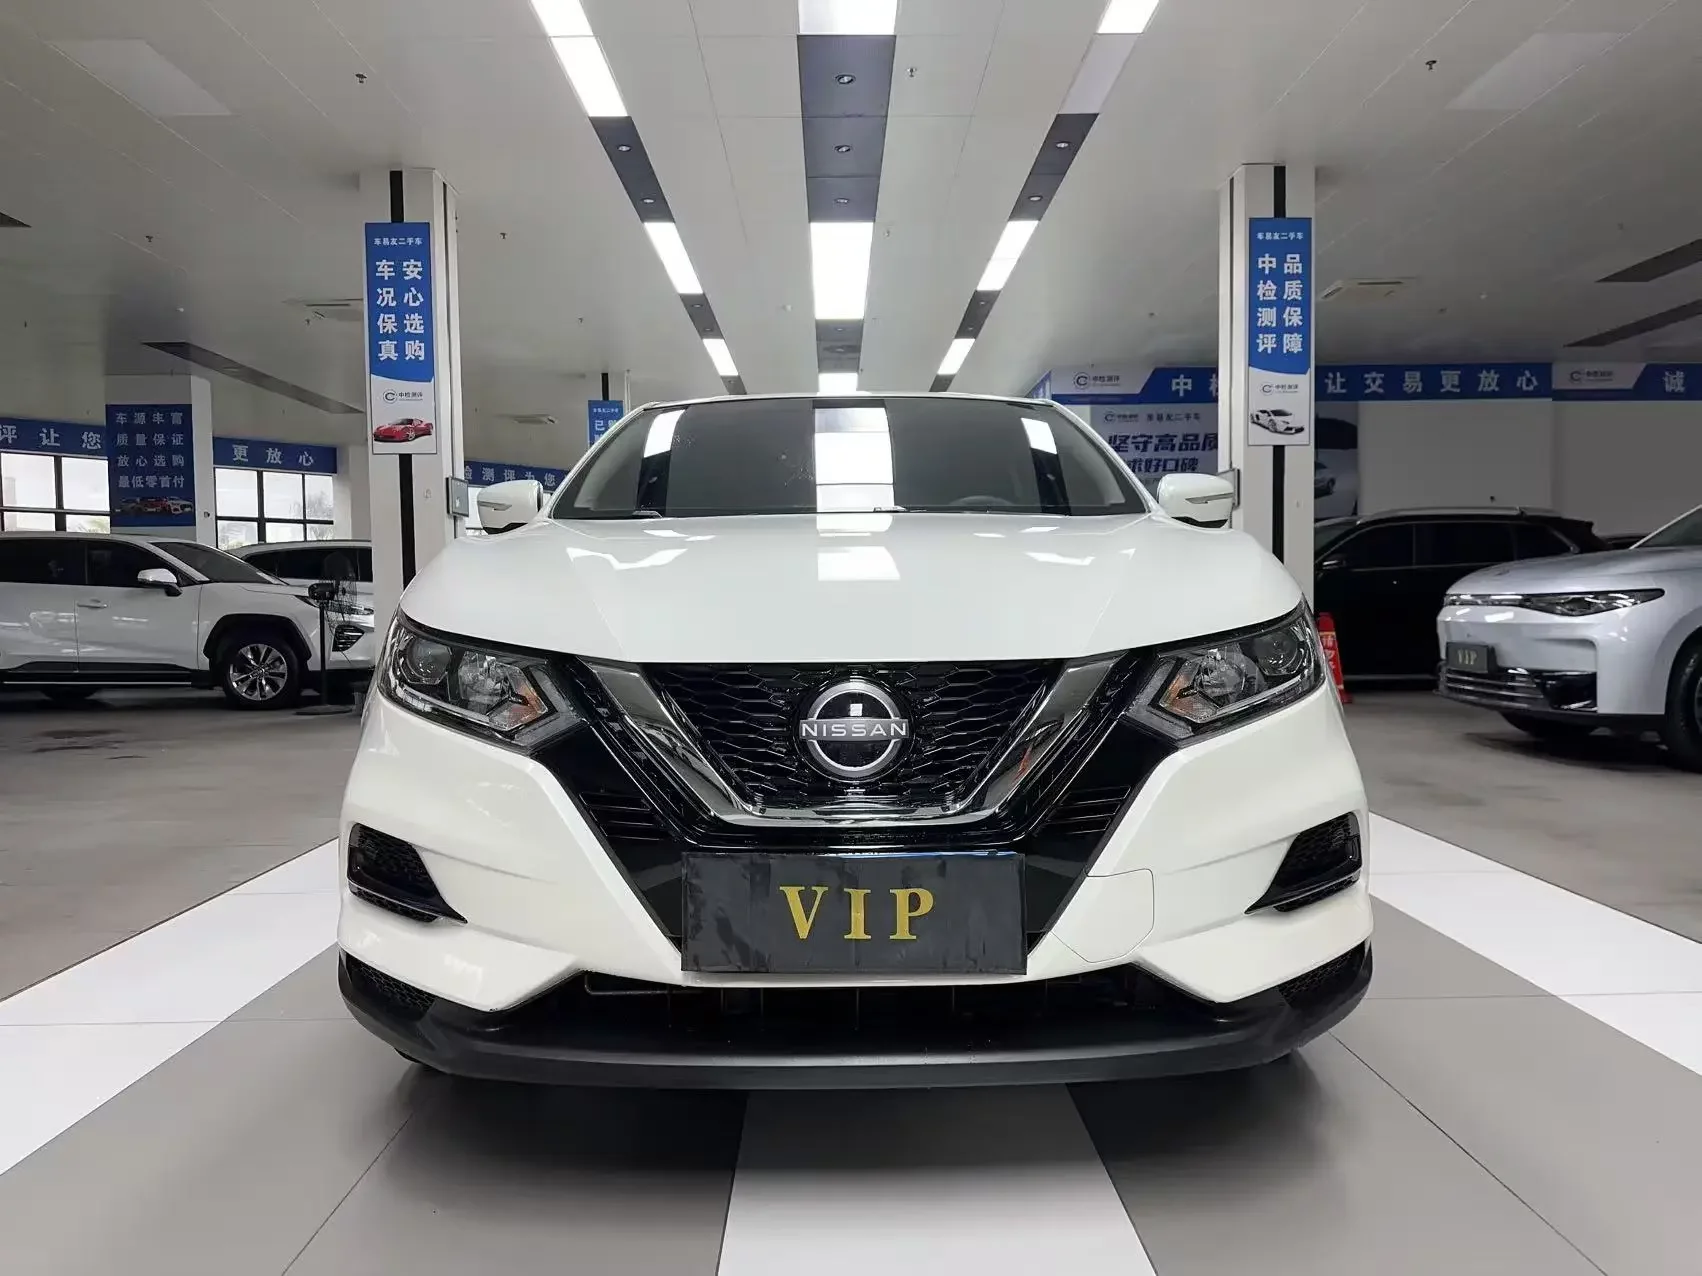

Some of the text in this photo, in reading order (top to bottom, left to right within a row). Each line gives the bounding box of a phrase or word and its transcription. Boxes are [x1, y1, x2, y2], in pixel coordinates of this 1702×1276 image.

[375, 259, 398, 361] 车况保真
[402, 259, 425, 361] 安心选购
[1257, 253, 1277, 354] 中检测评
[1283, 253, 1303, 354] 品质保障
[1325, 370, 1538, 394] 让交易更放心
[1663, 370, 1686, 393] 诚
[115, 411, 184, 426] 车源丰富
[116, 432, 184, 447] 质量保证
[116, 454, 185, 468] 放心选购
[231, 444, 314, 467] 更放心
[118, 475, 185, 489] 最低零首付
[1457, 648, 1478, 665] VIP
[801, 722, 907, 737] NISSAN
[779, 885, 935, 940] VIP
